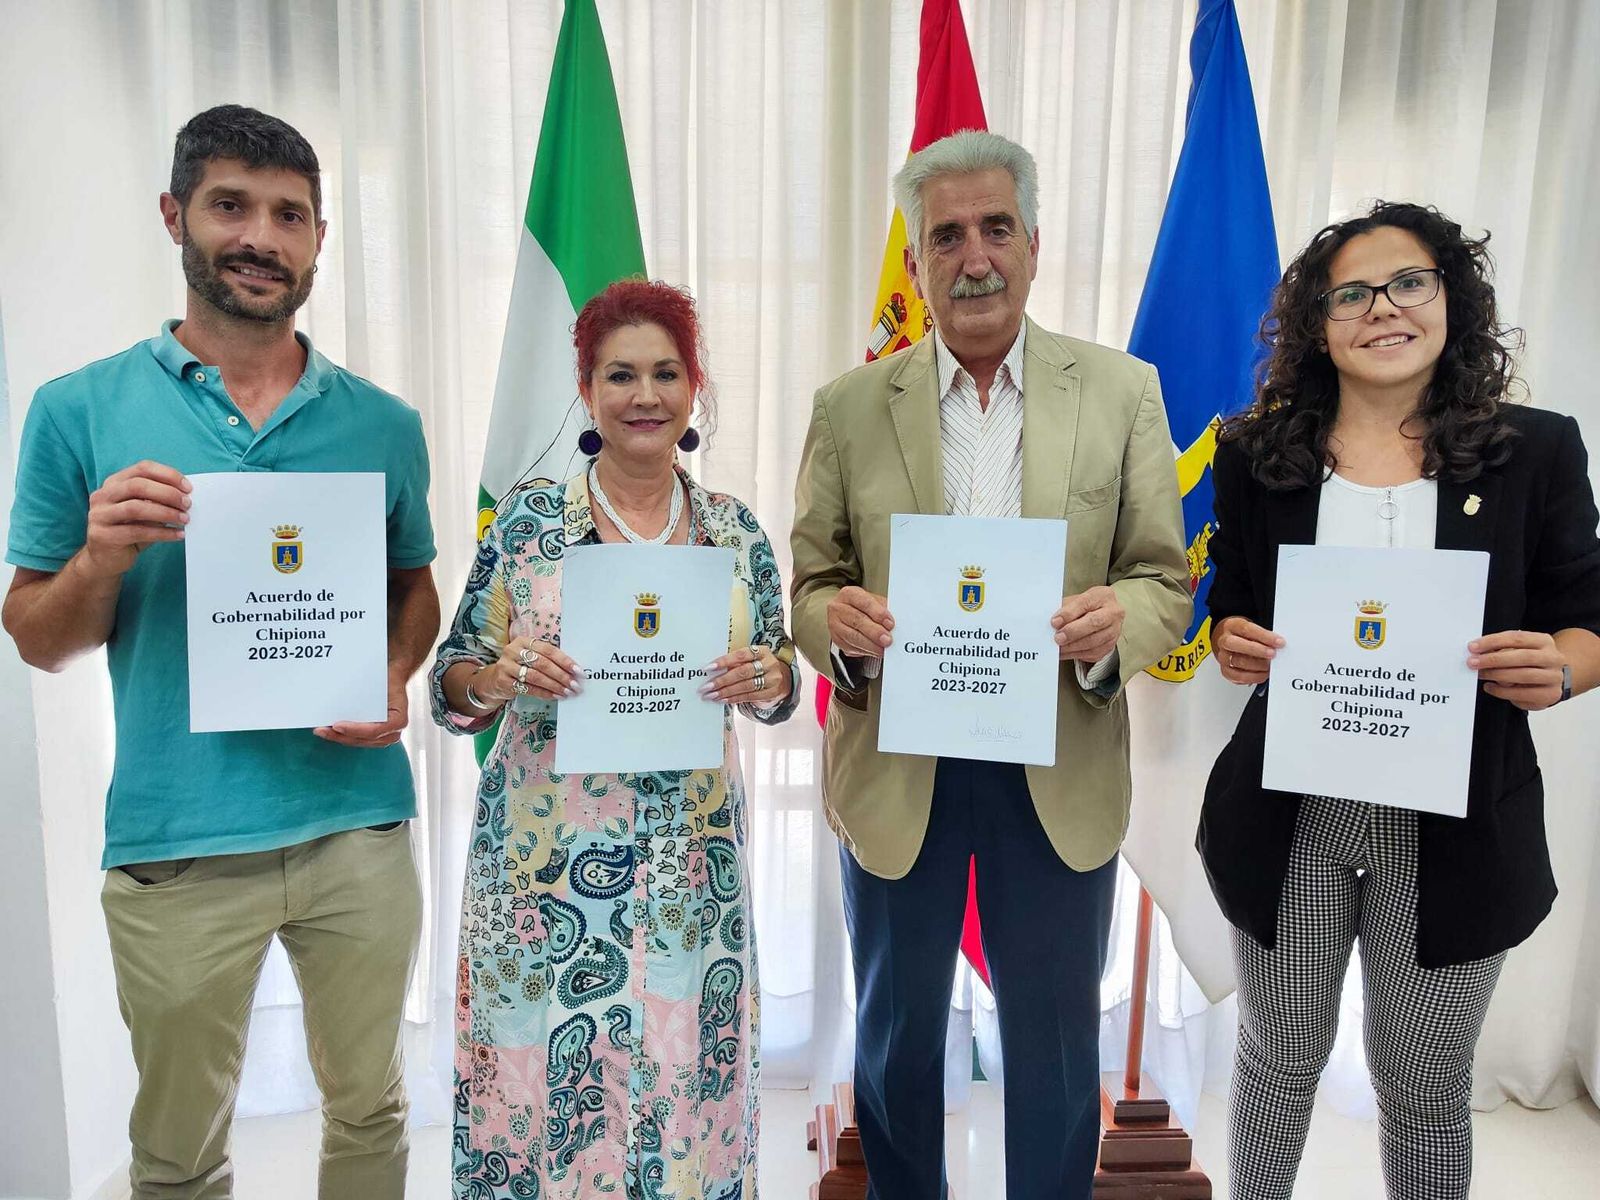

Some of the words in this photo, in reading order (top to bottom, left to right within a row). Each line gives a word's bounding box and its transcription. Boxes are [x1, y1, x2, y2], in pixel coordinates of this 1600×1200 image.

[245, 590, 312, 604] Acuerdo
[316, 589, 334, 602] de
[211, 608, 335, 624] Gobernabilidad
[340, 610, 366, 623] por
[255, 627, 326, 643] Chipiona
[933, 626, 990, 640] Acuerdo
[994, 629, 1010, 641] de
[248, 644, 333, 660] 2023-2027
[609, 652, 666, 664] Acuerdo
[669, 651, 685, 662] de
[904, 642, 1010, 660] Gobernabilidad
[1014, 650, 1039, 663] por
[583, 668, 685, 681] Gobernabilidad
[938, 661, 1001, 677] Chipiona
[1324, 662, 1392, 680] Acuerdo
[1396, 669, 1416, 682] de
[616, 685, 676, 699] Chipiona
[931, 678, 1007, 695] 2023-2027
[1291, 678, 1415, 701] Gobernabilidad
[1420, 693, 1450, 705] por
[609, 699, 681, 714] 2023-2027
[1330, 701, 1403, 719] Chipiona
[1322, 717, 1410, 738] 2023-2027
